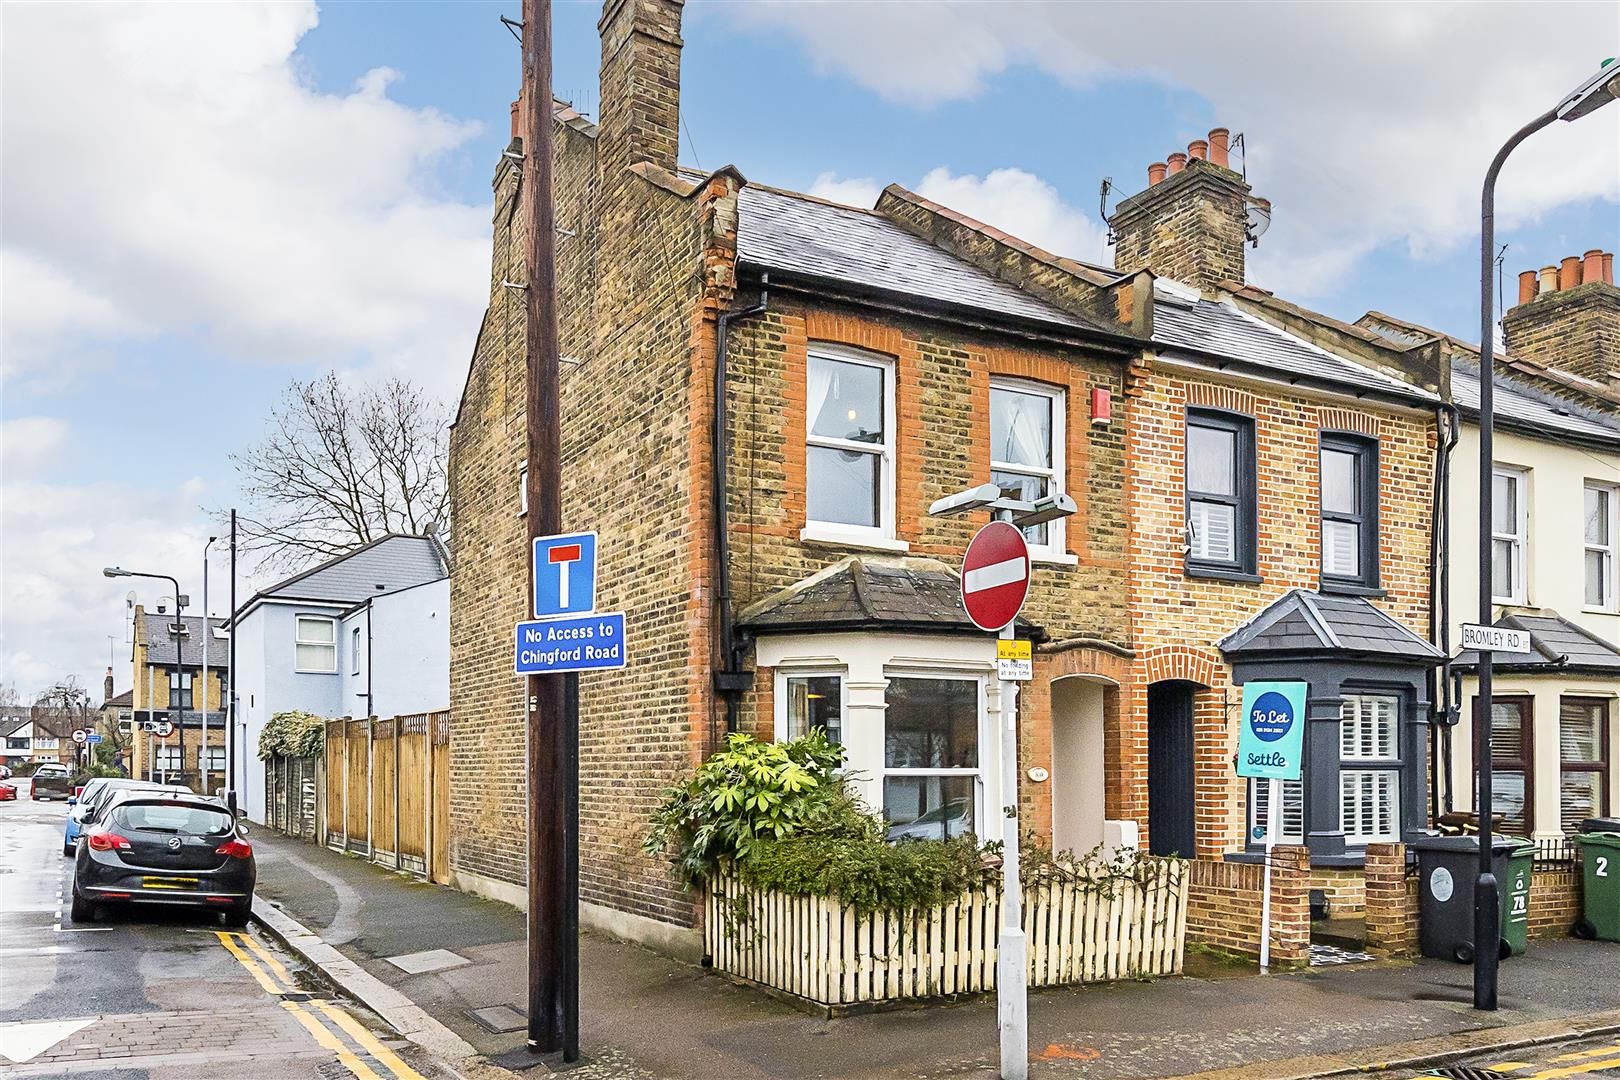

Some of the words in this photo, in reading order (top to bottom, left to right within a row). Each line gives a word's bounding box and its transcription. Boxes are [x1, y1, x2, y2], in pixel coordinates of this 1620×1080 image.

[525, 628, 542, 643] No
[547, 626, 593, 641] Access
[599, 622, 614, 637] to
[1465, 629, 1504, 647] BROMLEY
[1507, 633, 1520, 648] RD
[521, 646, 581, 665] Chingford
[585, 644, 619, 660] Road
[1253, 710, 1266, 723] To
[1267, 710, 1290, 724] Let
[1247, 752, 1286, 767] Settle
[1596, 857, 1608, 877] 2
[1513, 895, 1525, 910] 78
